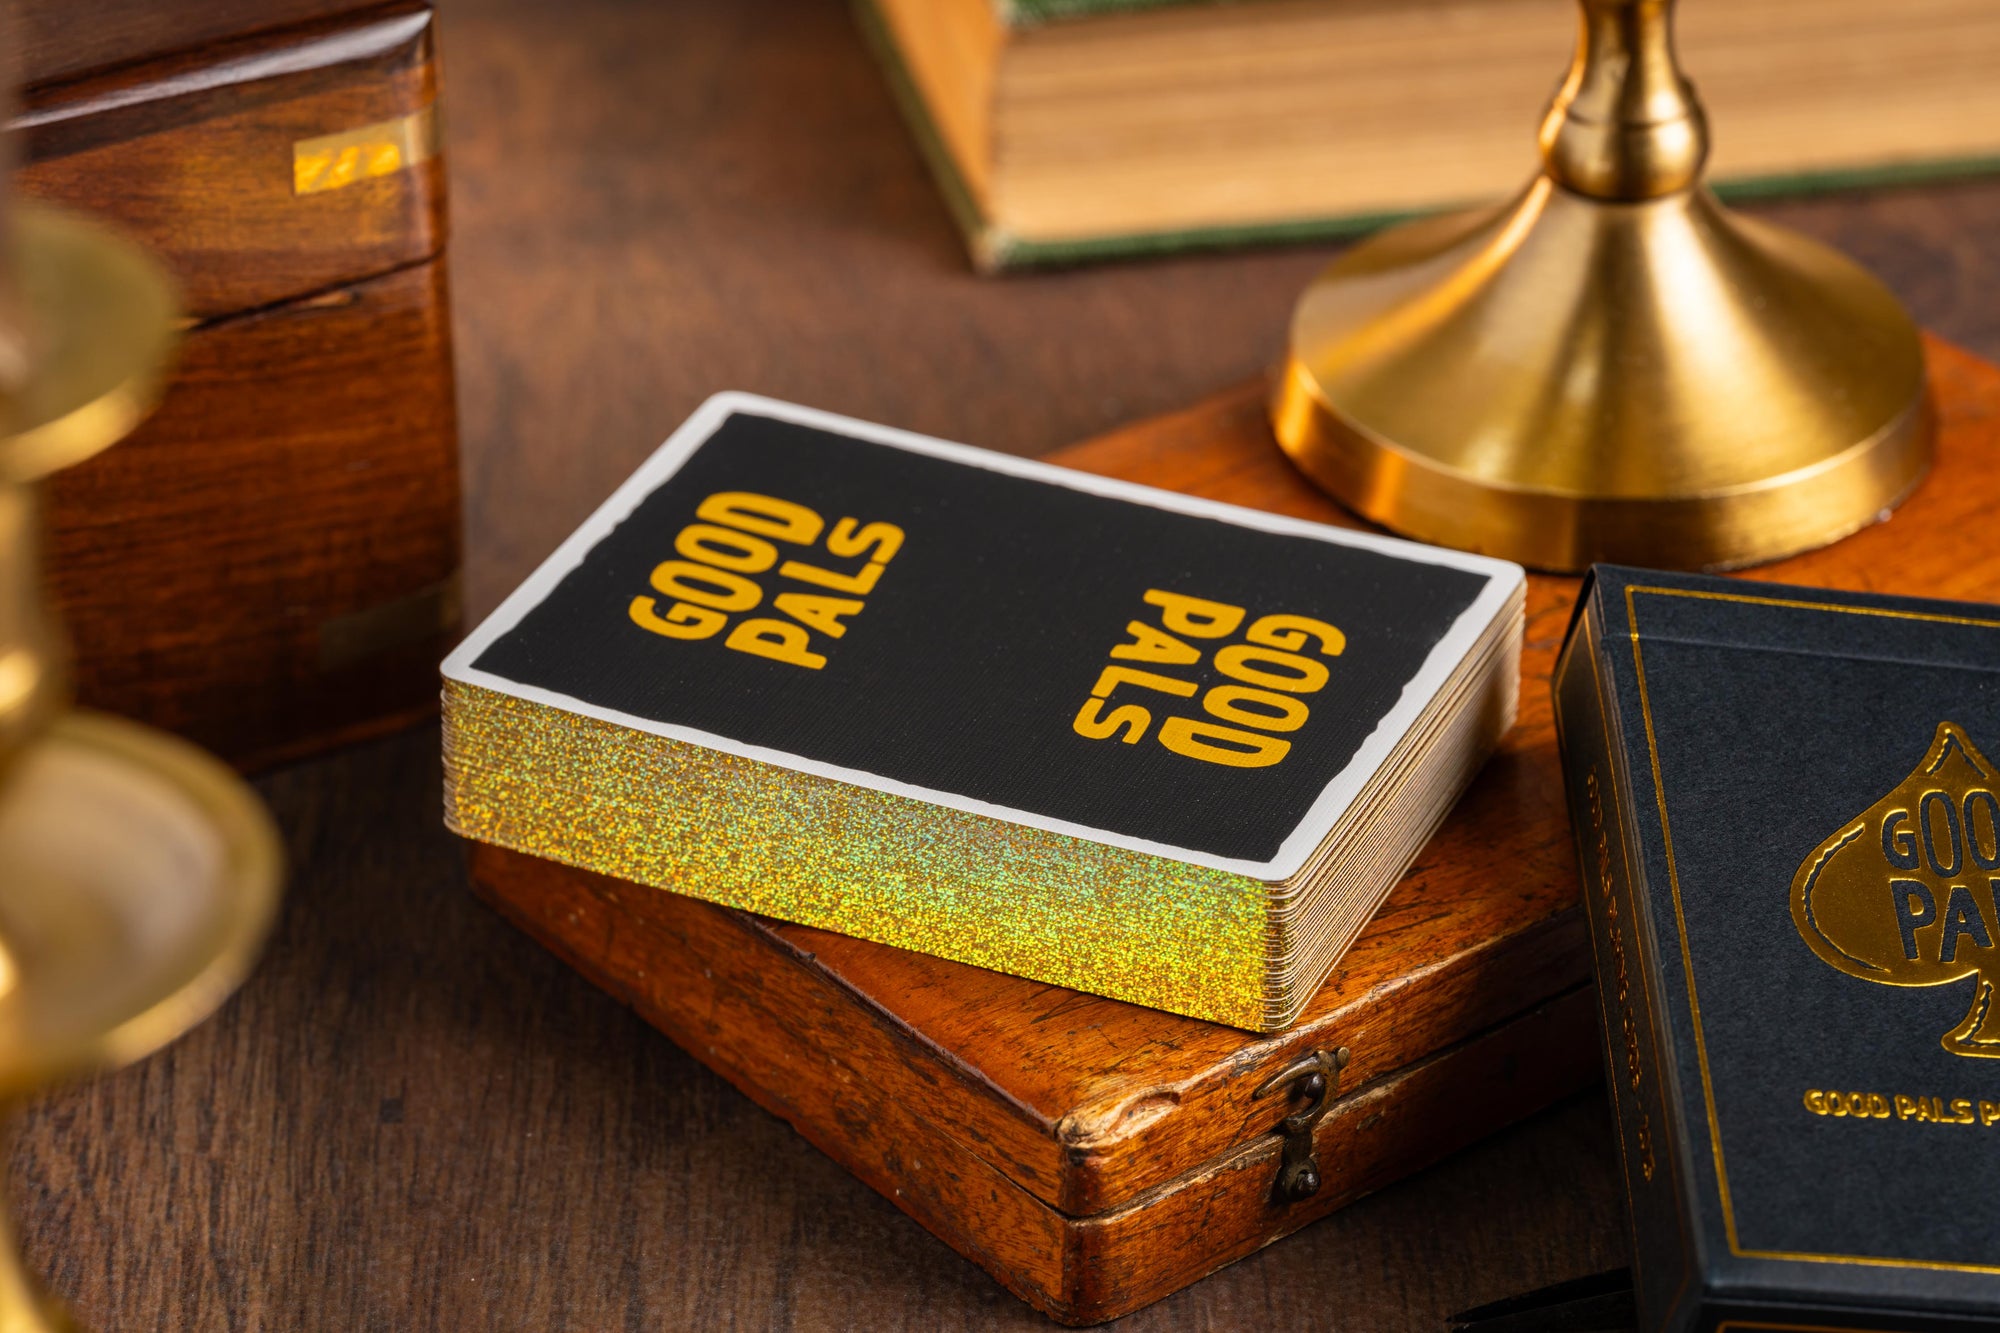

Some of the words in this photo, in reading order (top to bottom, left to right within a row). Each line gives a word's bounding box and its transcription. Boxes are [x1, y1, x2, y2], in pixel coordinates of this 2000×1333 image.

[628, 492, 825, 640] GOOD
[723, 516, 906, 671] PALS
[1073, 588, 1247, 745] PALS
[1158, 613, 1347, 768] GOOD
[1888, 876, 2000, 963] PA
[1803, 1088, 1891, 1119] GOOD
[1893, 1093, 1976, 1125] PALS
[1978, 1100, 2000, 1127] P
